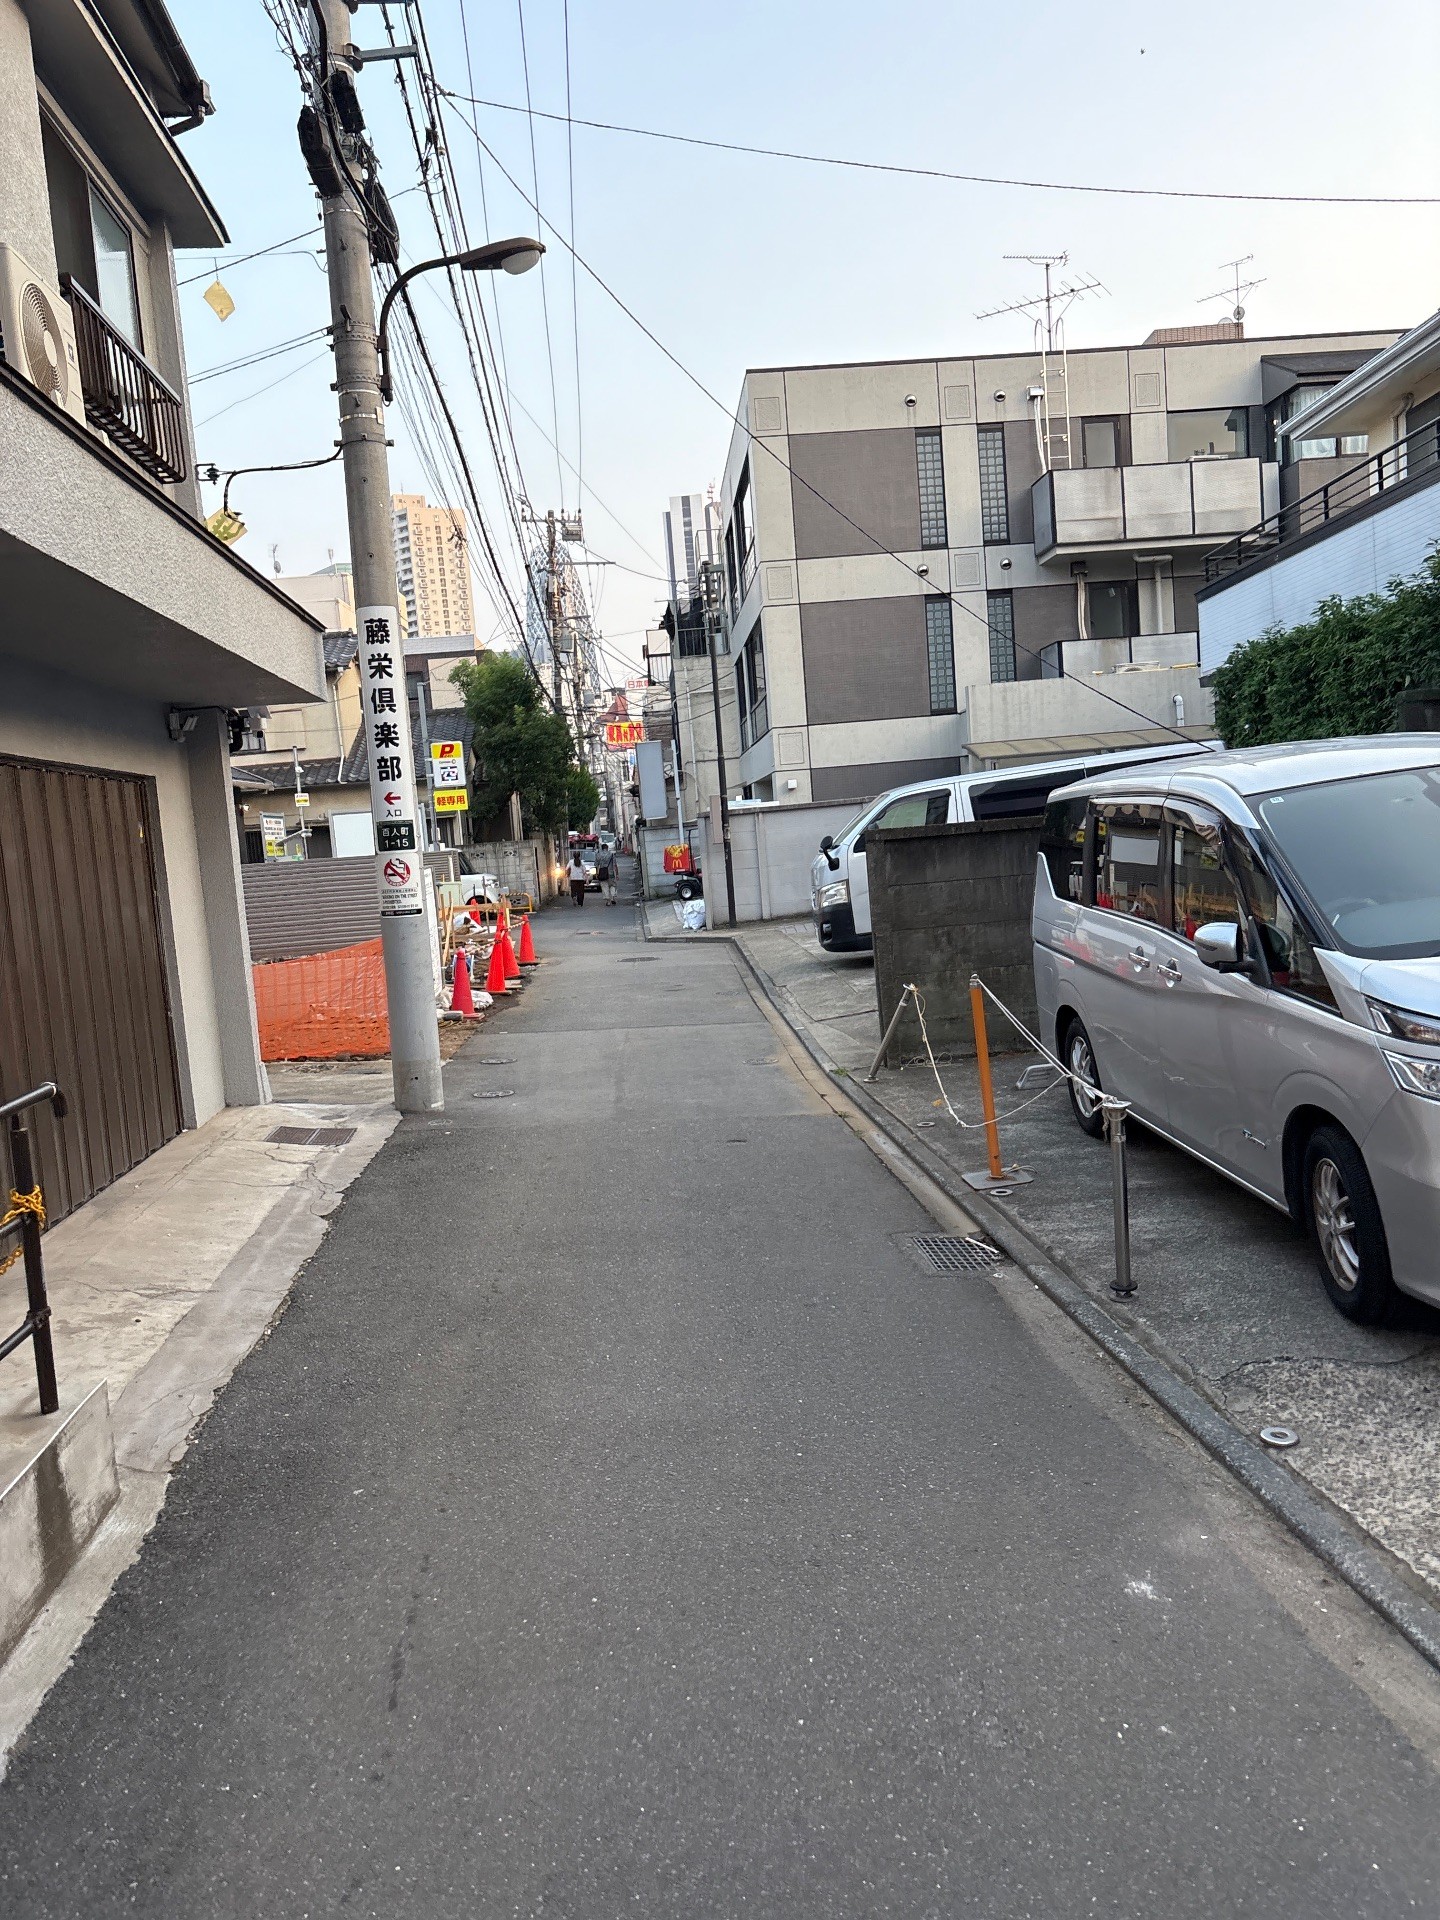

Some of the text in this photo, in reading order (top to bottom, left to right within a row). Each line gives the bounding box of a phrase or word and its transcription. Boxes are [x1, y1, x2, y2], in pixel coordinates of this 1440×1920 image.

[364, 618, 402, 781] 藤栄倶楽部
[439, 744, 454, 758] P
[440, 766, 458, 781] 空
[436, 795, 465, 806] 軽専用
[386, 809, 402, 818] 入口
[382, 826, 409, 837] 百人町
[384, 838, 409, 848] 1-15
